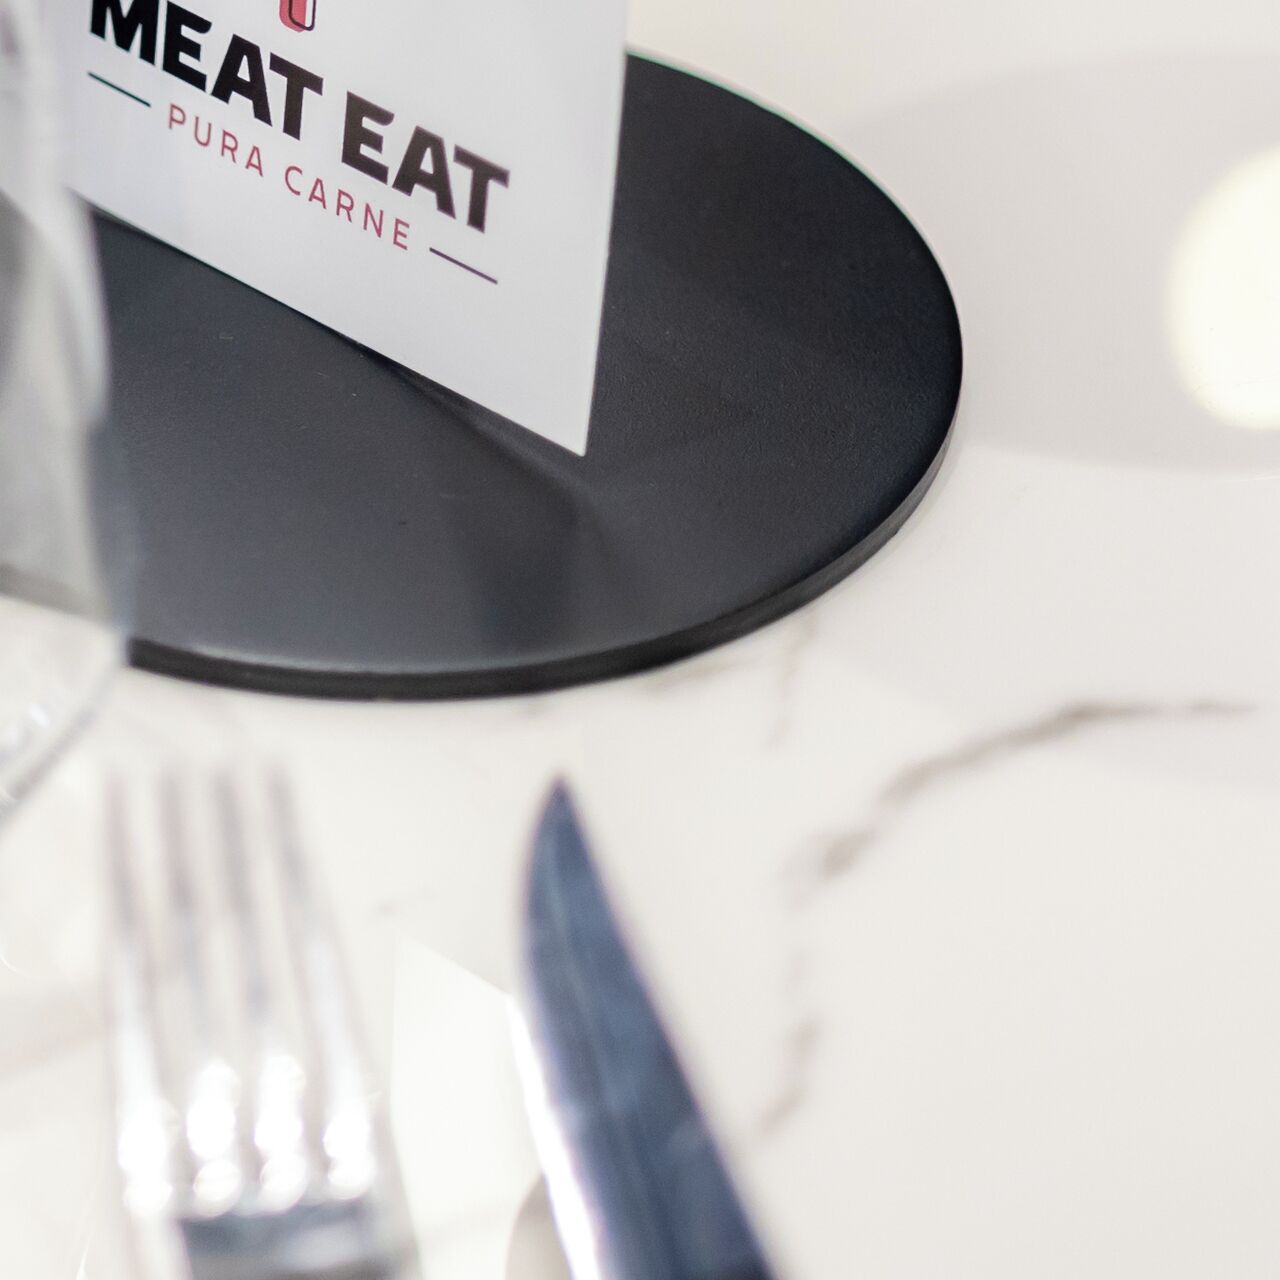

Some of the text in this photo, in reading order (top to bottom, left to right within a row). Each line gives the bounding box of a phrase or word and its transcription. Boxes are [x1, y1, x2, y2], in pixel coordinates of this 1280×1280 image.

[166, 103, 410, 251] PURA CARNE
[341, 90, 511, 234] EAT
